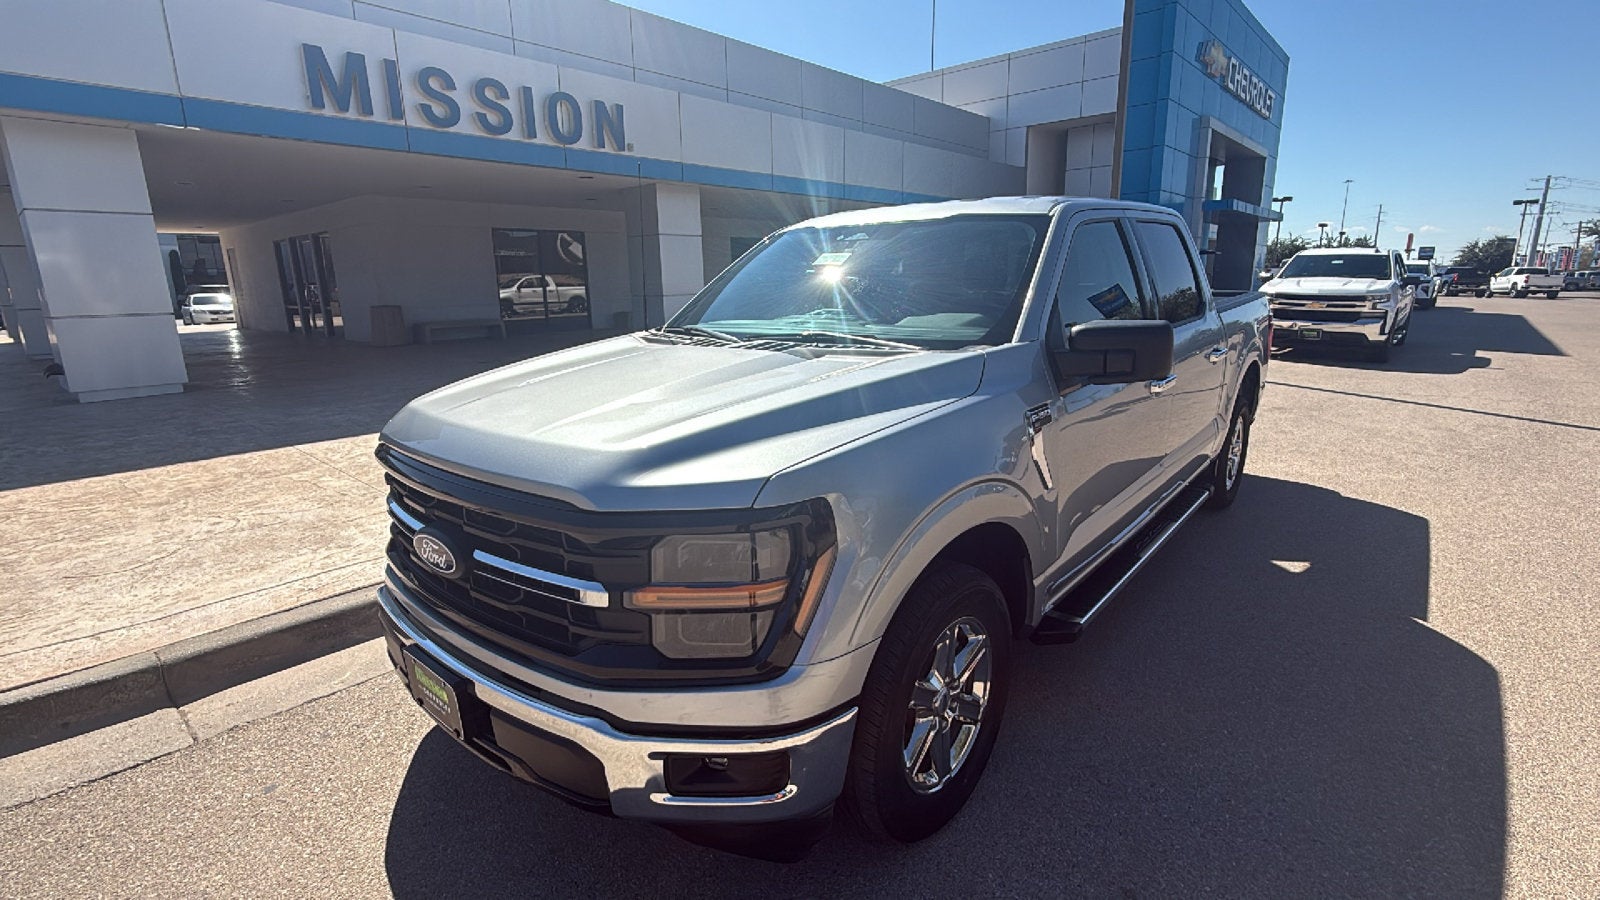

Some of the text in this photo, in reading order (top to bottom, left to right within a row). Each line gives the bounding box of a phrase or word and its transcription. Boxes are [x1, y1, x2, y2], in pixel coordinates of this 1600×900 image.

[302, 43, 626, 152] MISSION
[1227, 56, 1276, 119] CHEVROLET
[421, 539, 447, 569] Ford
